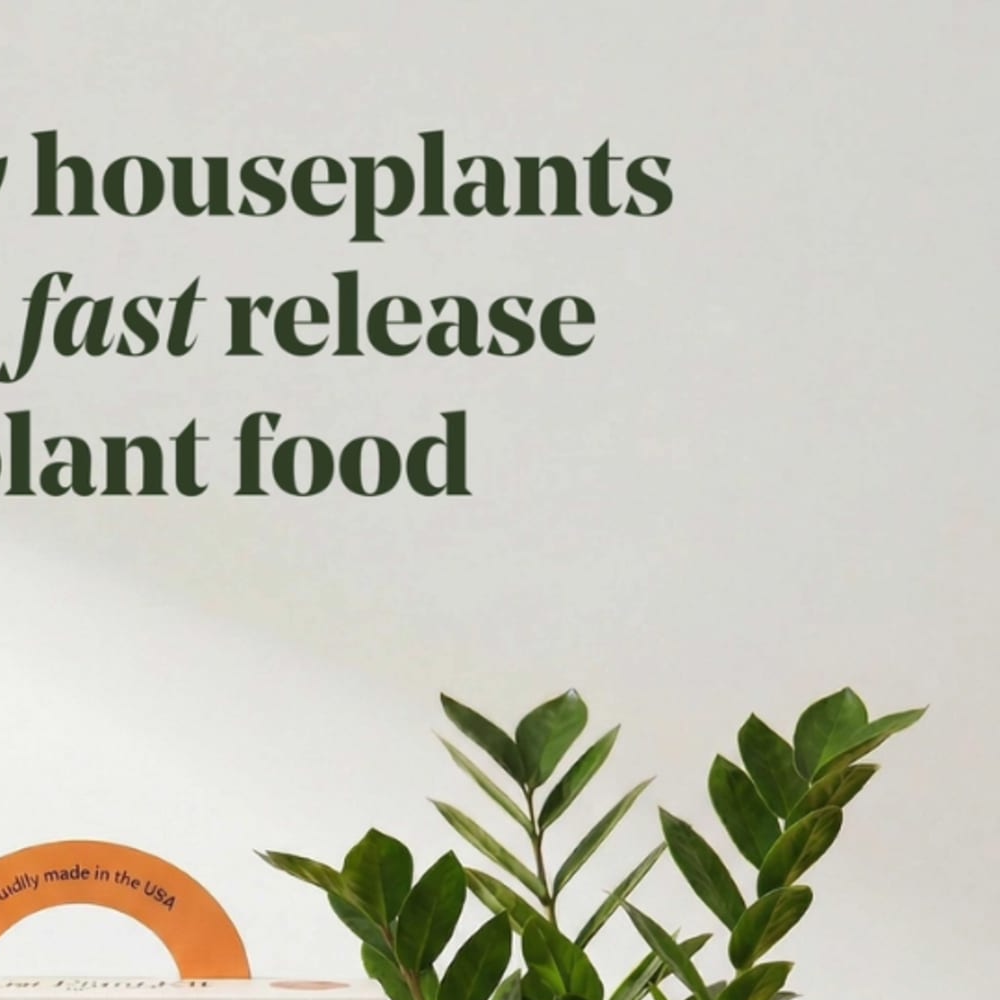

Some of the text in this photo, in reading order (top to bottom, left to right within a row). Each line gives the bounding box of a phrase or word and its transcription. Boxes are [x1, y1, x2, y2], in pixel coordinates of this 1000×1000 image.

[44, 864, 91, 883] made
[94, 865, 110, 881] in
[114, 869, 141, 890] the
[143, 880, 177, 912] USA
